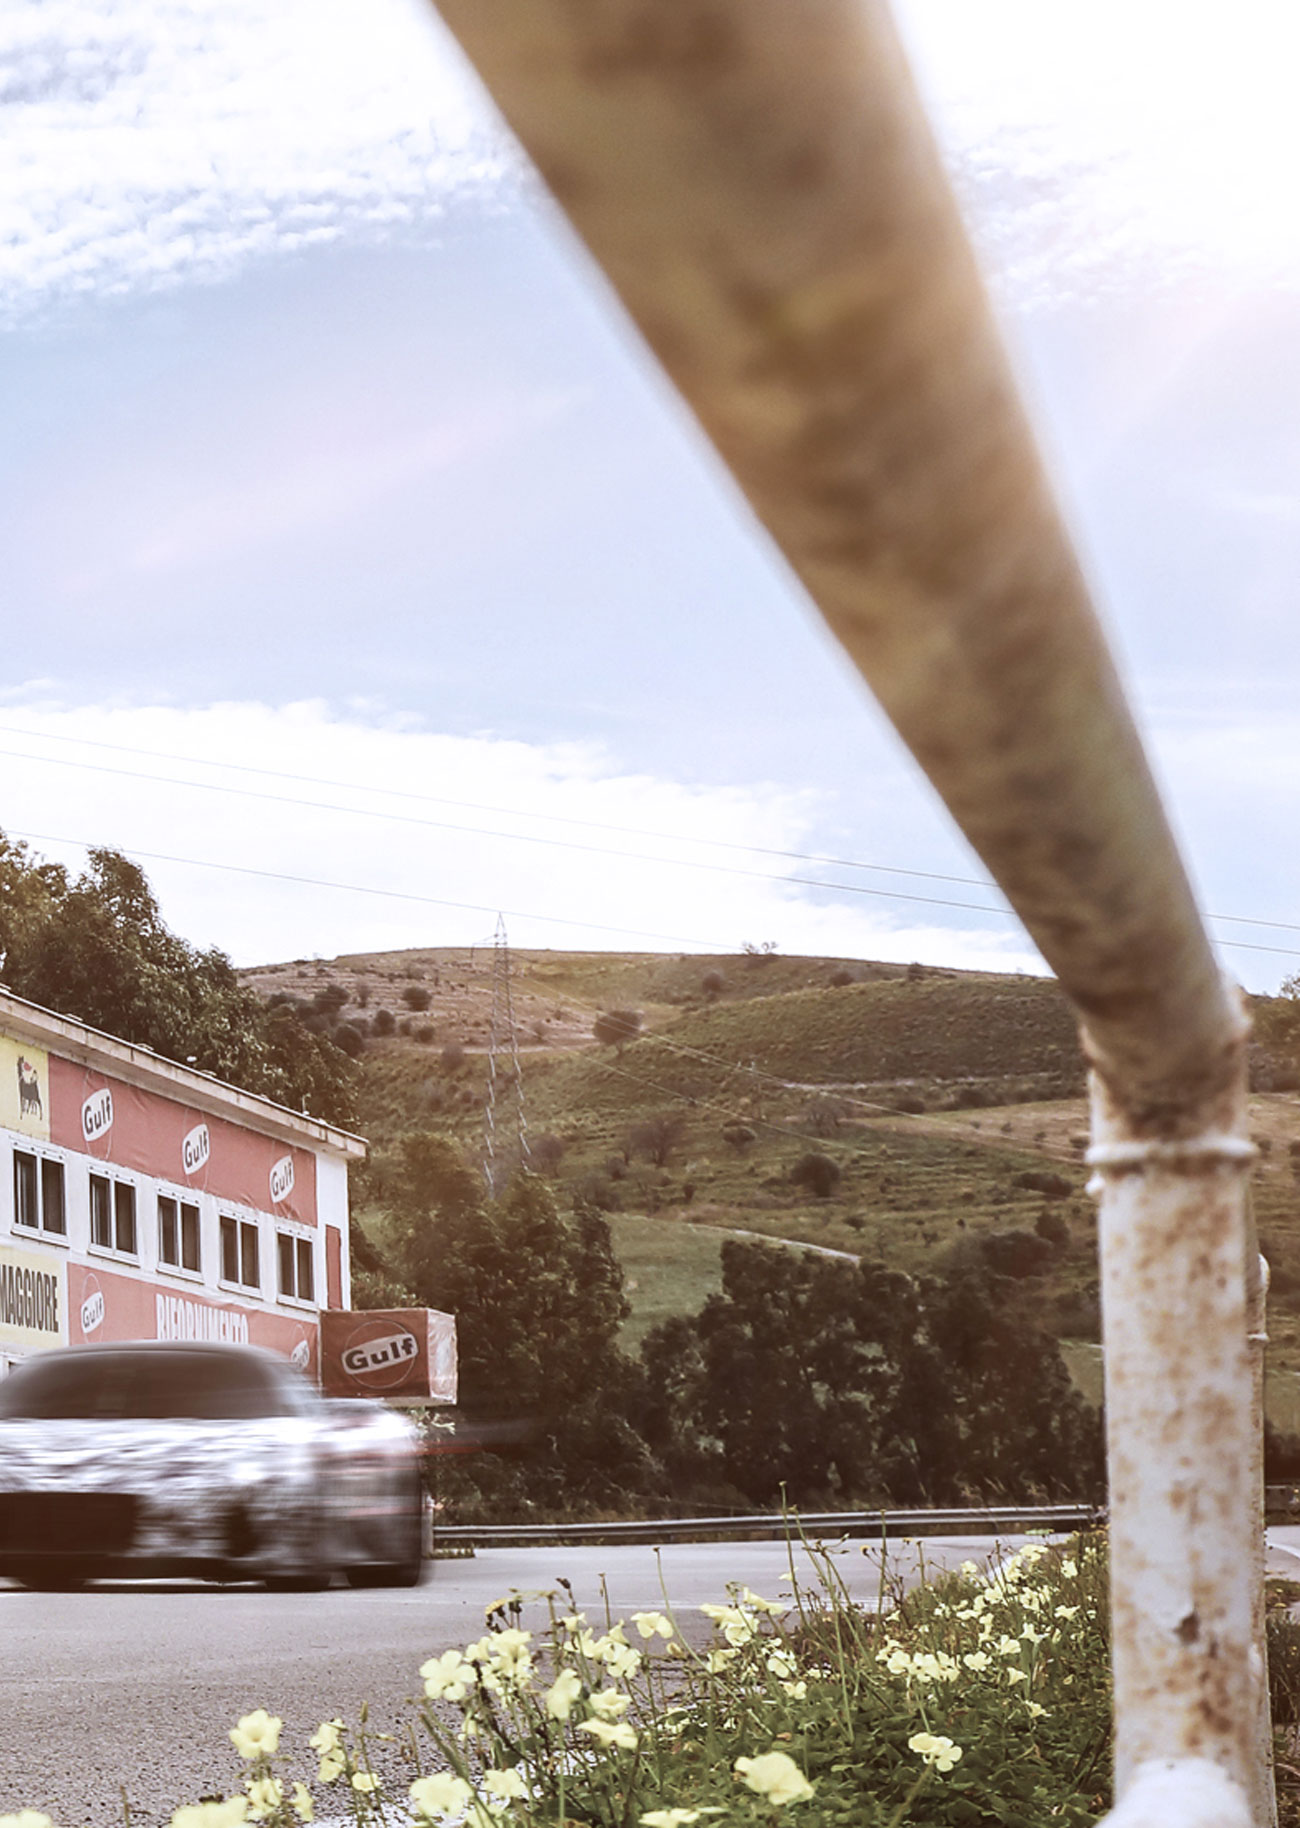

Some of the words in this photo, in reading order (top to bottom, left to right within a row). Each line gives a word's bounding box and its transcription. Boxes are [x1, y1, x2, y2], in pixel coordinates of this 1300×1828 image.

[84, 1096, 111, 1135] Gulf
[184, 1129, 208, 1169] Gulf
[271, 1161, 293, 1197] Gulf
[82, 1297, 102, 1328] Gulf
[345, 1338, 412, 1370] Gulf
